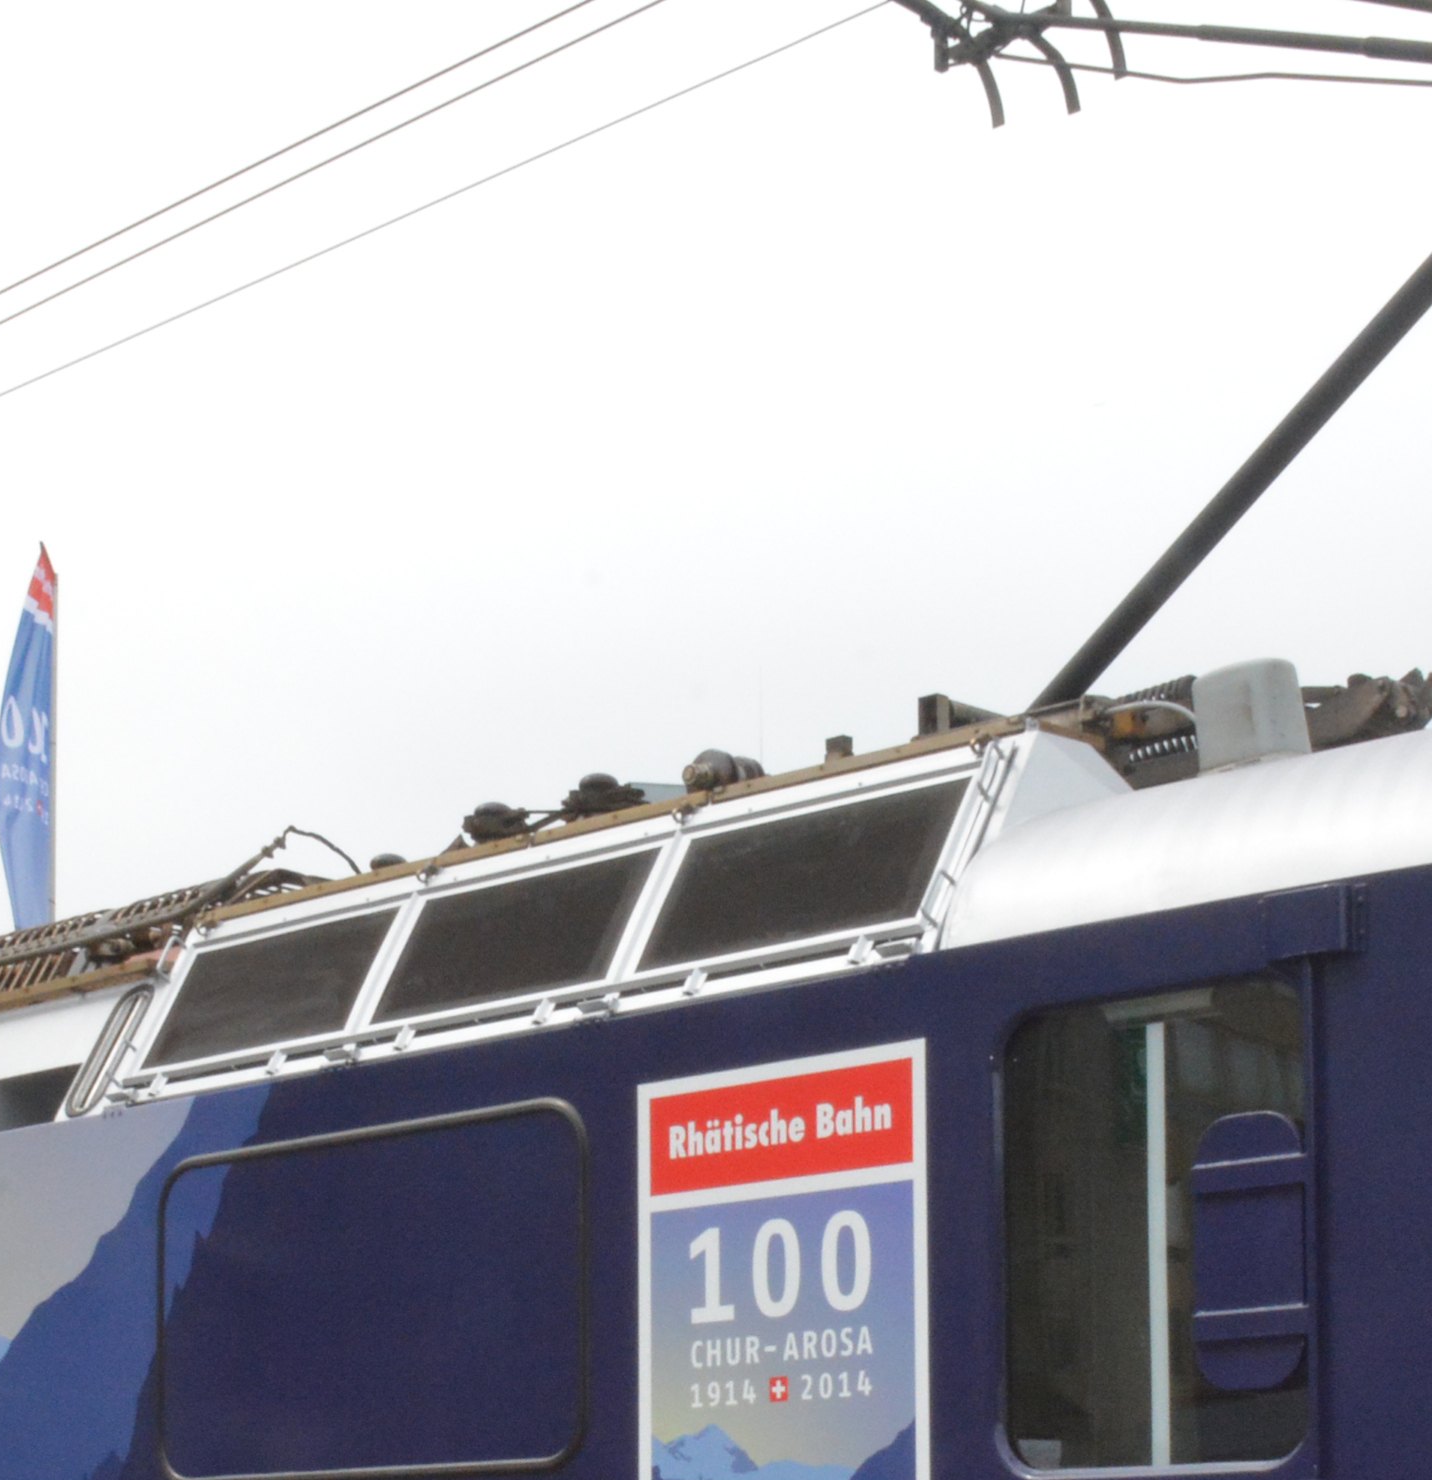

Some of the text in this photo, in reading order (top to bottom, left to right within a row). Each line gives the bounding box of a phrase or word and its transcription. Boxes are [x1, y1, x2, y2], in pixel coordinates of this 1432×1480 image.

[669, 1095, 892, 1160] Rhätische Bahn
[689, 1210, 872, 1324] 100
[690, 1326, 873, 1369] CHUR-AROSA
[690, 1370, 872, 1409] 1914 2014
